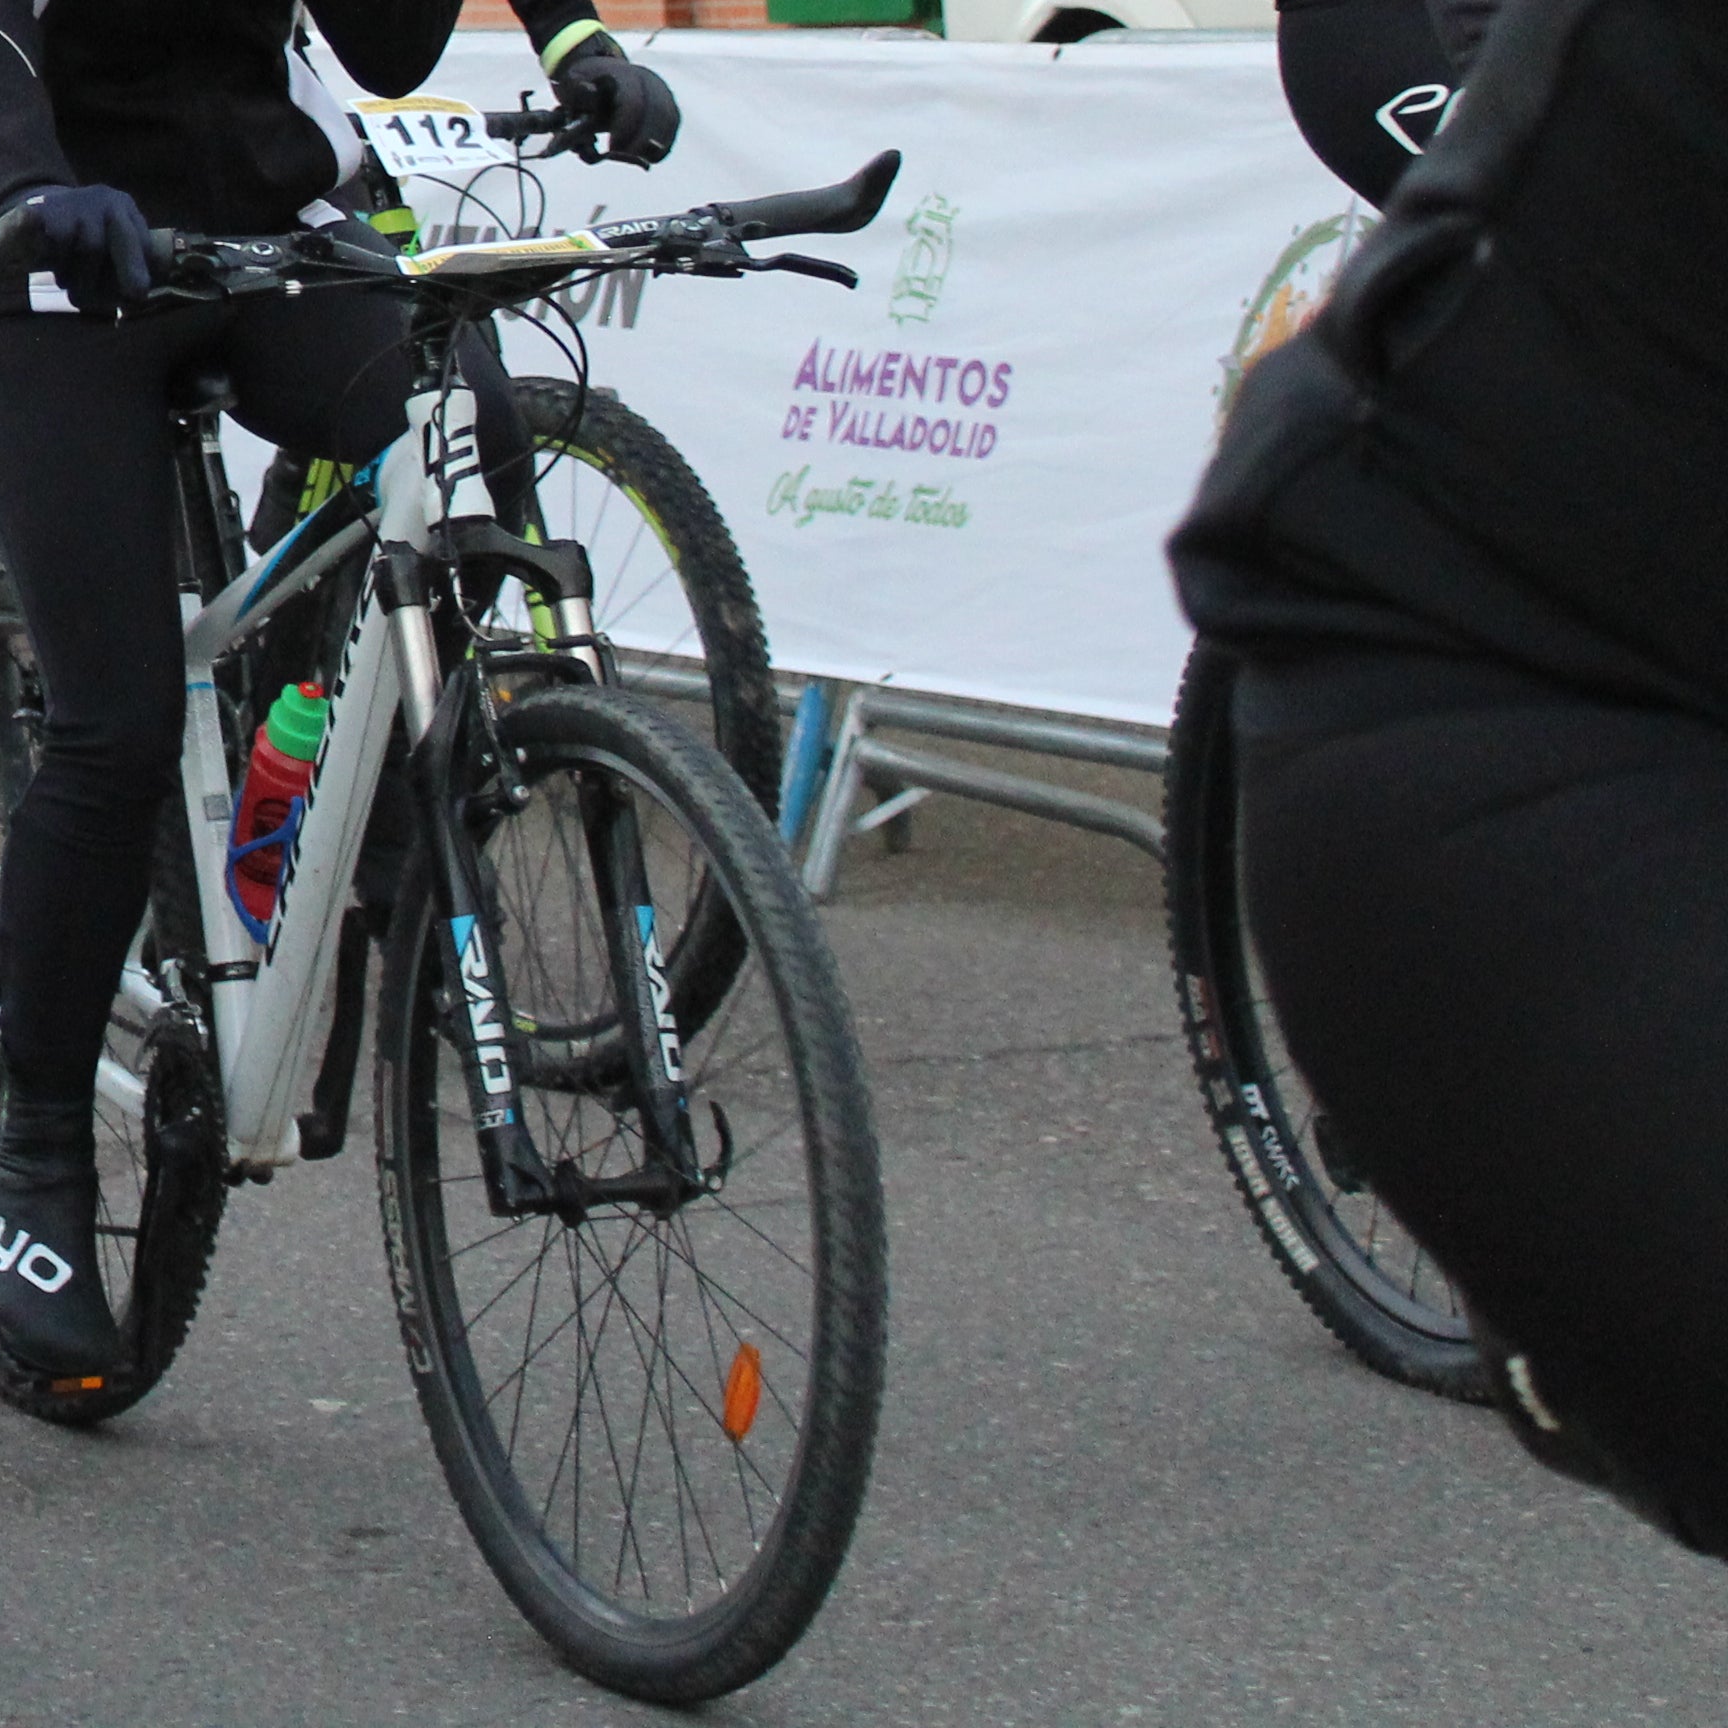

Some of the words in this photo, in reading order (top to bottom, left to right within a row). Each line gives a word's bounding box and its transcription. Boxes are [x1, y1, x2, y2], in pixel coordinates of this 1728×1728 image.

[384, 114, 484, 149] 112
[792, 336, 1014, 409] ALIMENTOS
[781, 405, 820, 442] DE
[828, 399, 998, 460] VALLADOLID
[766, 464, 805, 517] A
[797, 475, 872, 528] gusto
[866, 477, 904, 521] de
[902, 483, 972, 529] todos
